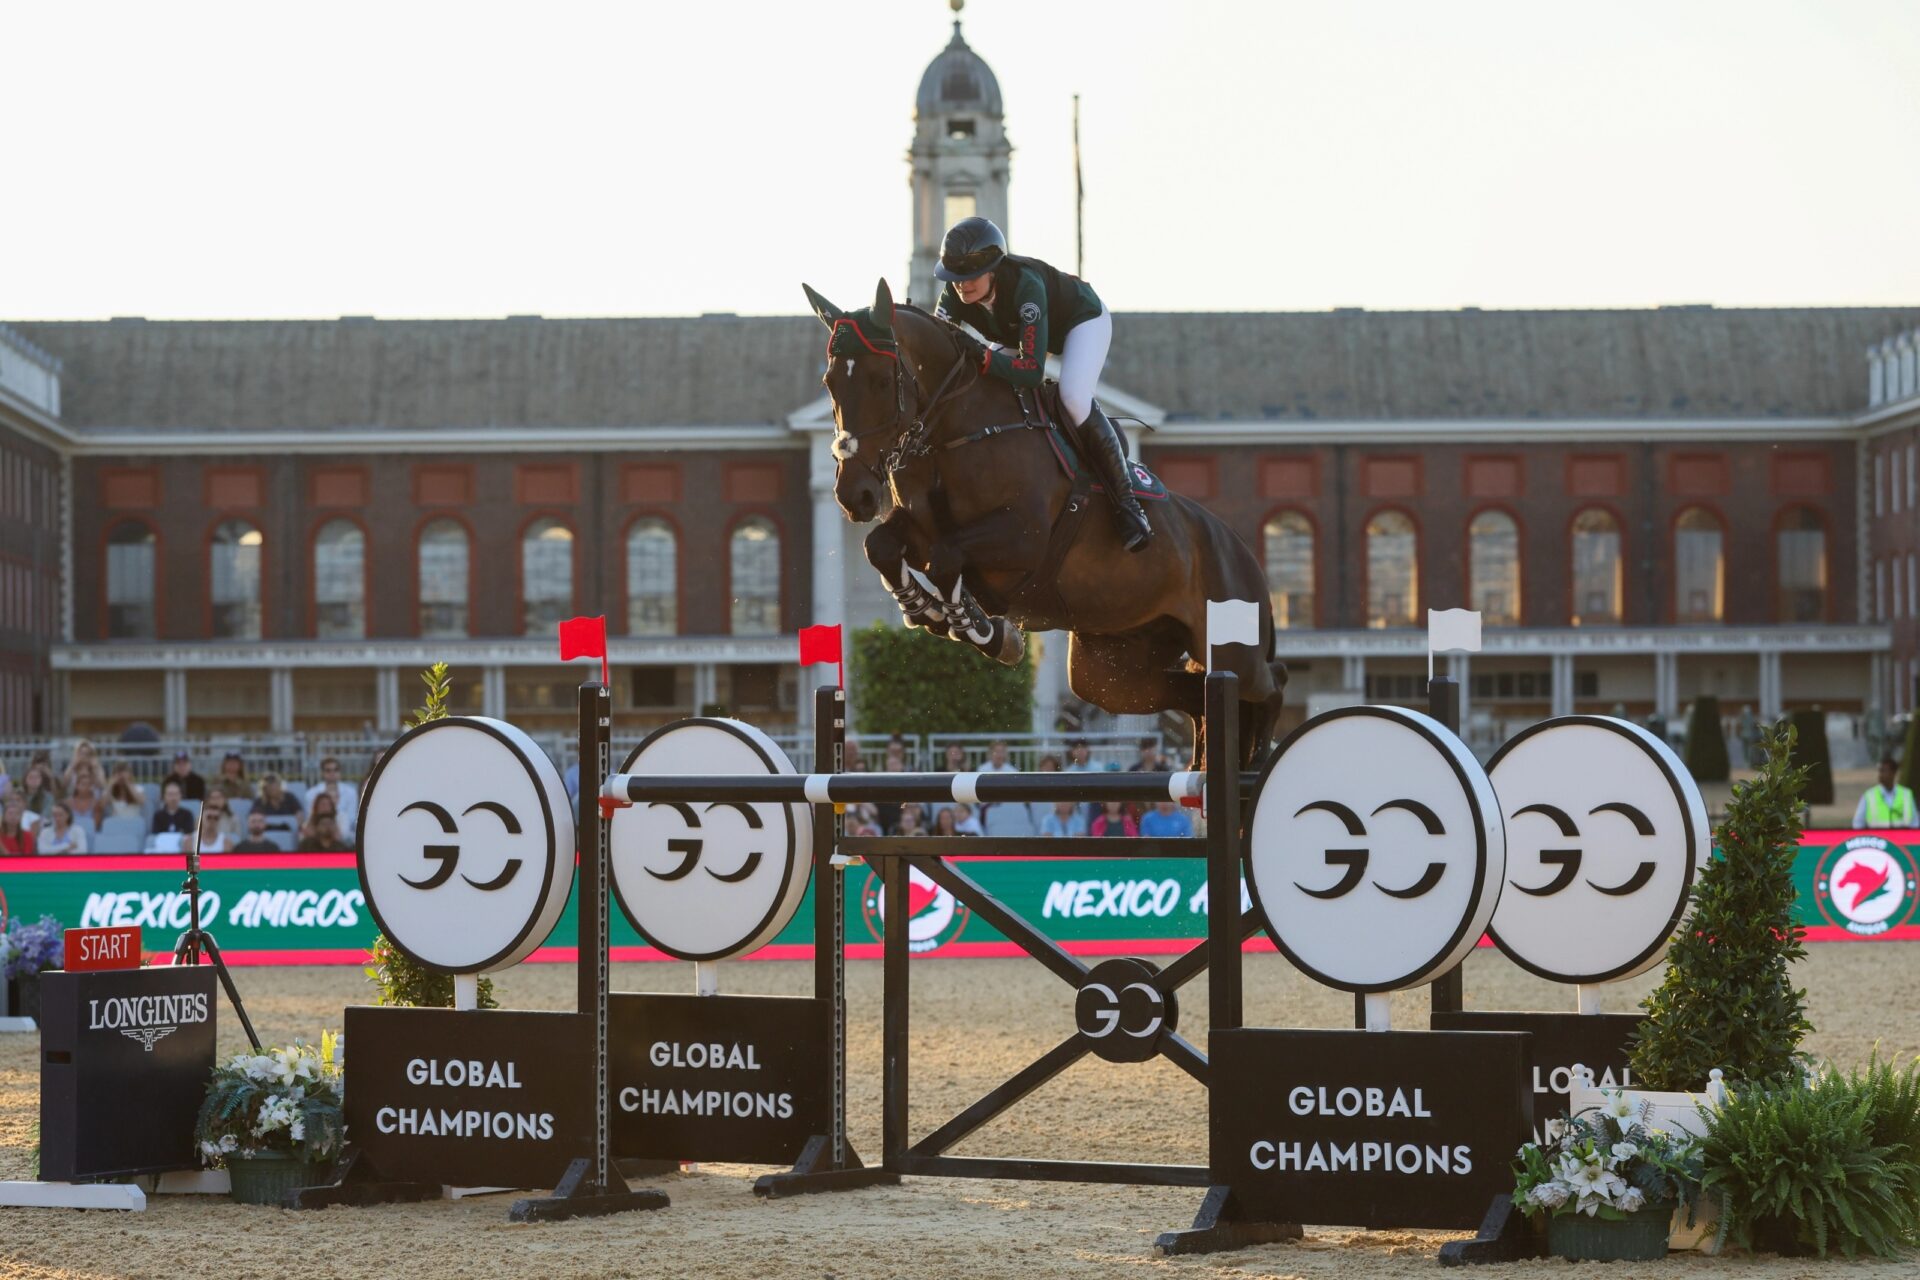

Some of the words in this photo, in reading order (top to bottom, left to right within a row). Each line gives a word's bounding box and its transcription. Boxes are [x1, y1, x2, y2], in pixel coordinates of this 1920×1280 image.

[397, 801, 523, 891] GC
[643, 802, 764, 882] GC
[1292, 799, 1447, 899] GC
[1508, 802, 1657, 896] GC
[80, 890, 221, 929] MEXICO
[228, 889, 366, 928] AMIGOS
[1042, 878, 1181, 918] MEXICO
[80, 933, 132, 962] START
[89, 993, 208, 1030] LONGINES
[1080, 982, 1162, 1037] GC
[406, 1058, 522, 1088] GLOBAL
[649, 1041, 761, 1070] GLOBAL
[619, 1087, 794, 1119] CHAMPIONS
[1288, 1086, 1432, 1118] GLOBAL
[376, 1107, 554, 1140] CHAMPIONS
[1250, 1140, 1472, 1175] CHAMPIONS
